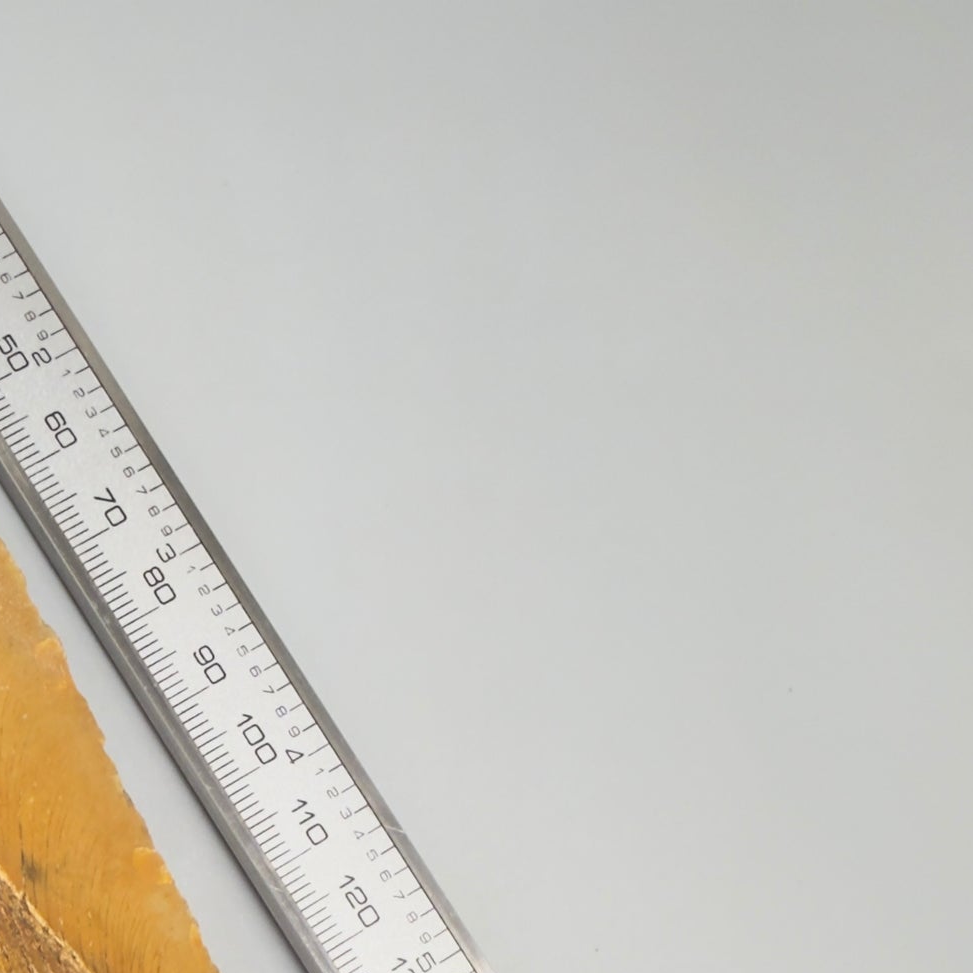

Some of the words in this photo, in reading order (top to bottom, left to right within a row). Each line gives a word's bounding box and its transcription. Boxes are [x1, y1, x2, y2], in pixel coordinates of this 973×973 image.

[31, 347, 52, 367] 2
[156, 543, 177, 563] 3
[285, 749, 304, 764] 4
[416, 951, 437, 973] 5
[44, 411, 77, 449] 60
[94, 487, 127, 527] 70
[143, 566, 177, 605] 80
[193, 645, 227, 685] 90
[237, 714, 277, 765] 100
[291, 799, 329, 846] 110
[339, 875, 380, 928] 120
